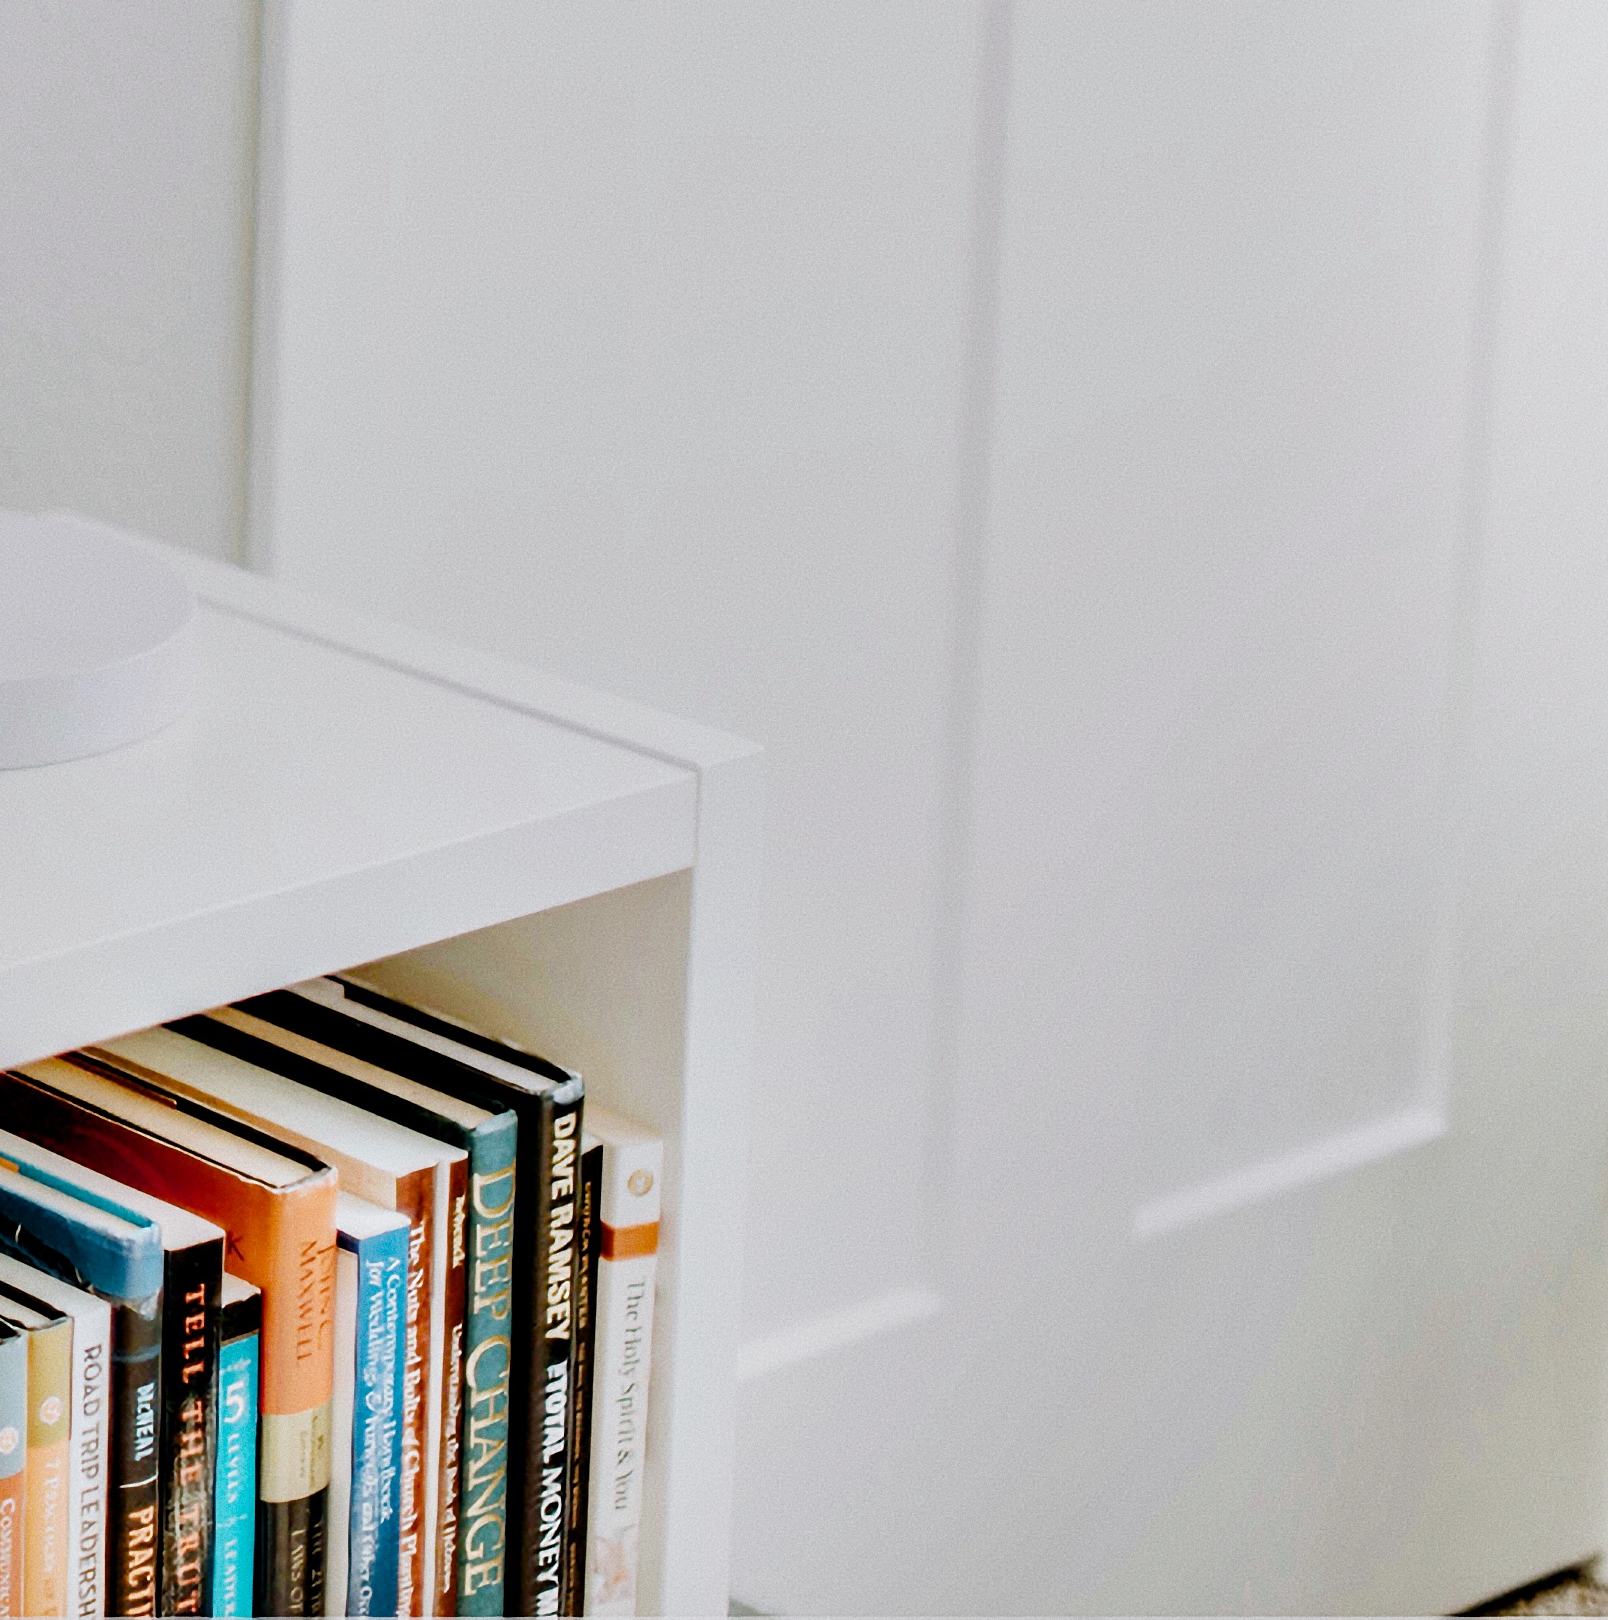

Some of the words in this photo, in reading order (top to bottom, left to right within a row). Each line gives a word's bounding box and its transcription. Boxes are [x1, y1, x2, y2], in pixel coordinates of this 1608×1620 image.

[549, 1111, 578, 1201] DAVE
[385, 1256, 401, 1271] A
[407, 1219, 426, 1265] The
[471, 1156, 517, 1319] DEEP
[316, 1243, 337, 1315] JOHN
[364, 1259, 385, 1286] for
[406, 1267, 425, 1323] Nuts
[543, 1201, 575, 1340] RAMSEY
[625, 1276, 647, 1322] The
[296, 1238, 319, 1366] MAXWELL
[181, 1283, 207, 1384] TELL
[405, 1325, 423, 1367] and
[617, 1325, 644, 1378] Holy
[82, 1344, 103, 1415] ROAD
[223, 1380, 245, 1423] 5
[404, 1368, 422, 1424] Bolts
[401, 1427, 420, 1448] of
[541, 1375, 568, 1464] TOTAL
[615, 1382, 639, 1445] Spirit
[80, 1423, 100, 1481] TRIP
[178, 1399, 205, 1487] THE
[465, 1335, 511, 1596] CHANGE
[616, 1448, 632, 1466] &
[361, 1501, 378, 1532] and
[401, 1448, 421, 1532] Church
[614, 1468, 636, 1512] You
[536, 1466, 564, 1585] MONEY
[125, 1505, 155, 1617] PRACTI
[535, 1584, 560, 1617] M
